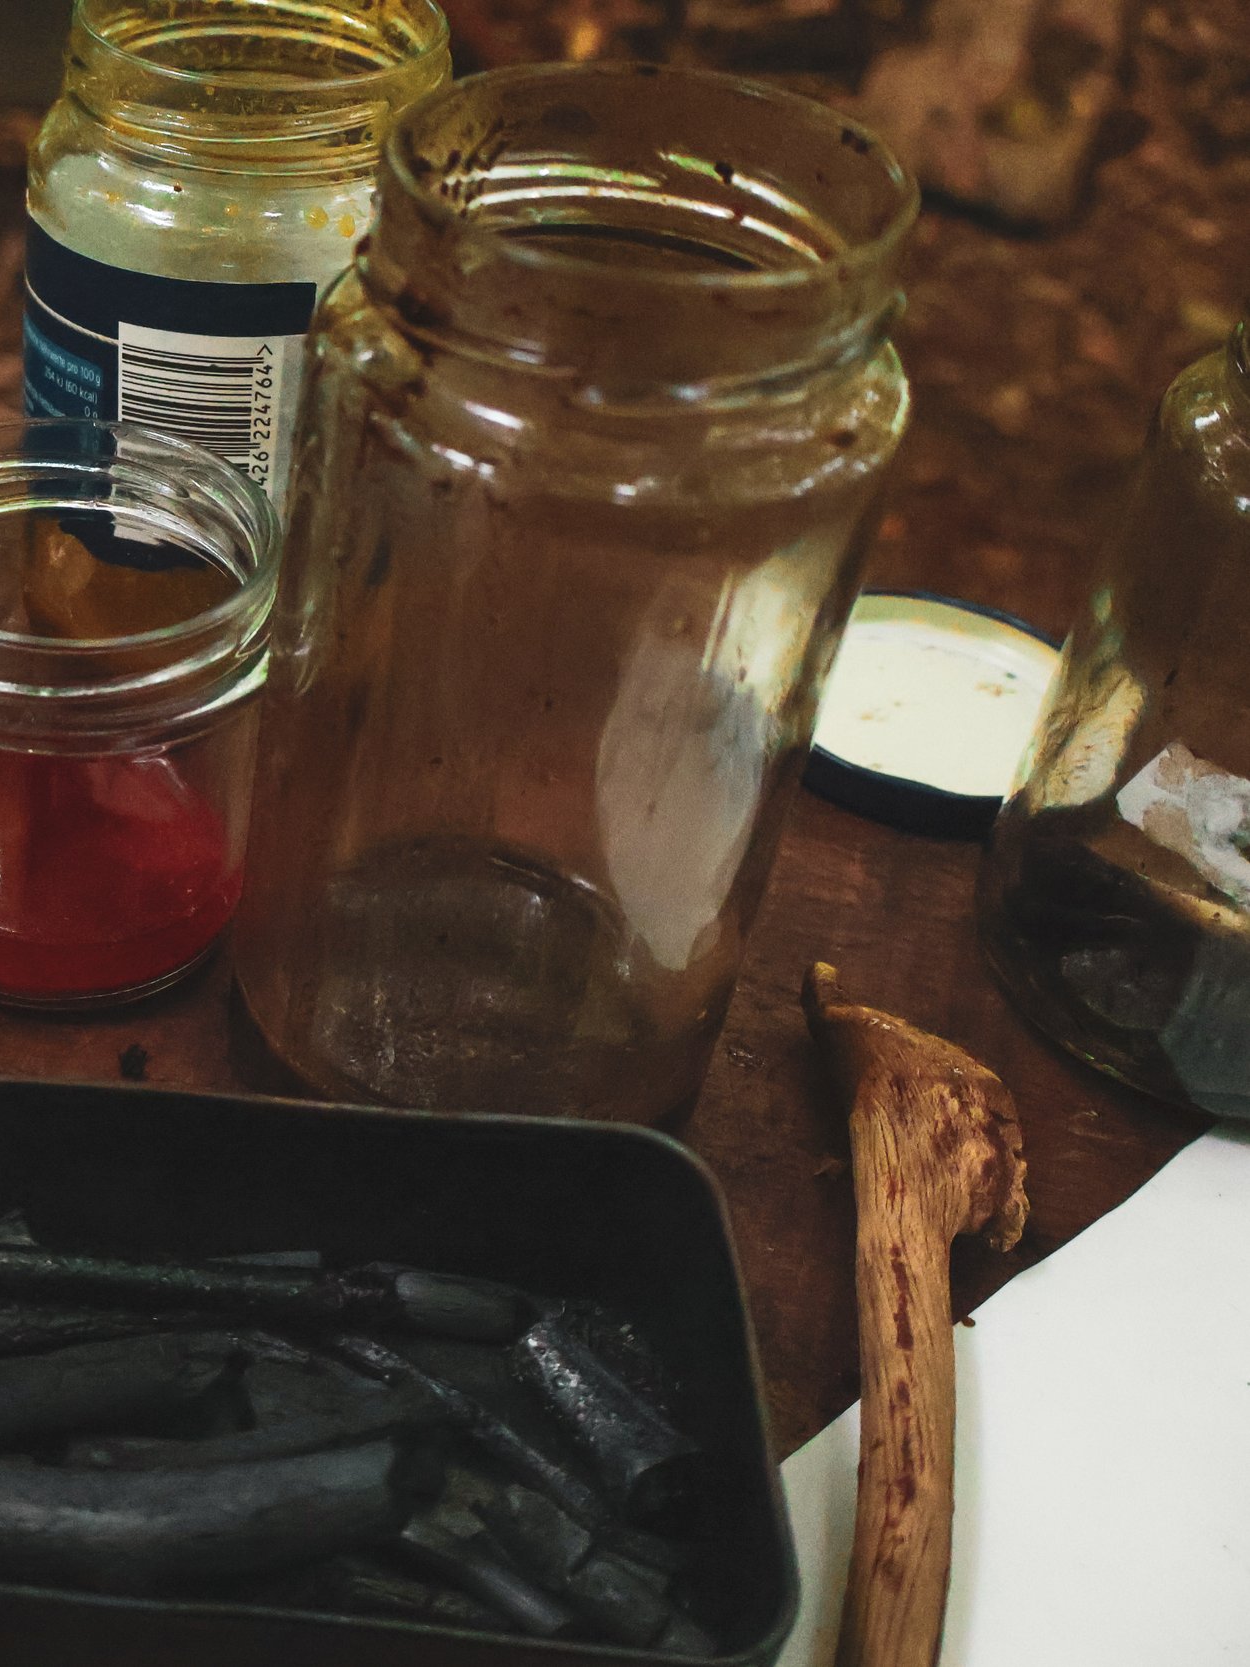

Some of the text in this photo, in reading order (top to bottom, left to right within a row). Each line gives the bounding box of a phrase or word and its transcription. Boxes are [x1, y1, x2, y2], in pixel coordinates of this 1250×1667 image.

[80, 366, 95, 382] 100
[95, 375, 101, 387] g
[79, 386, 98, 405] kcal)
